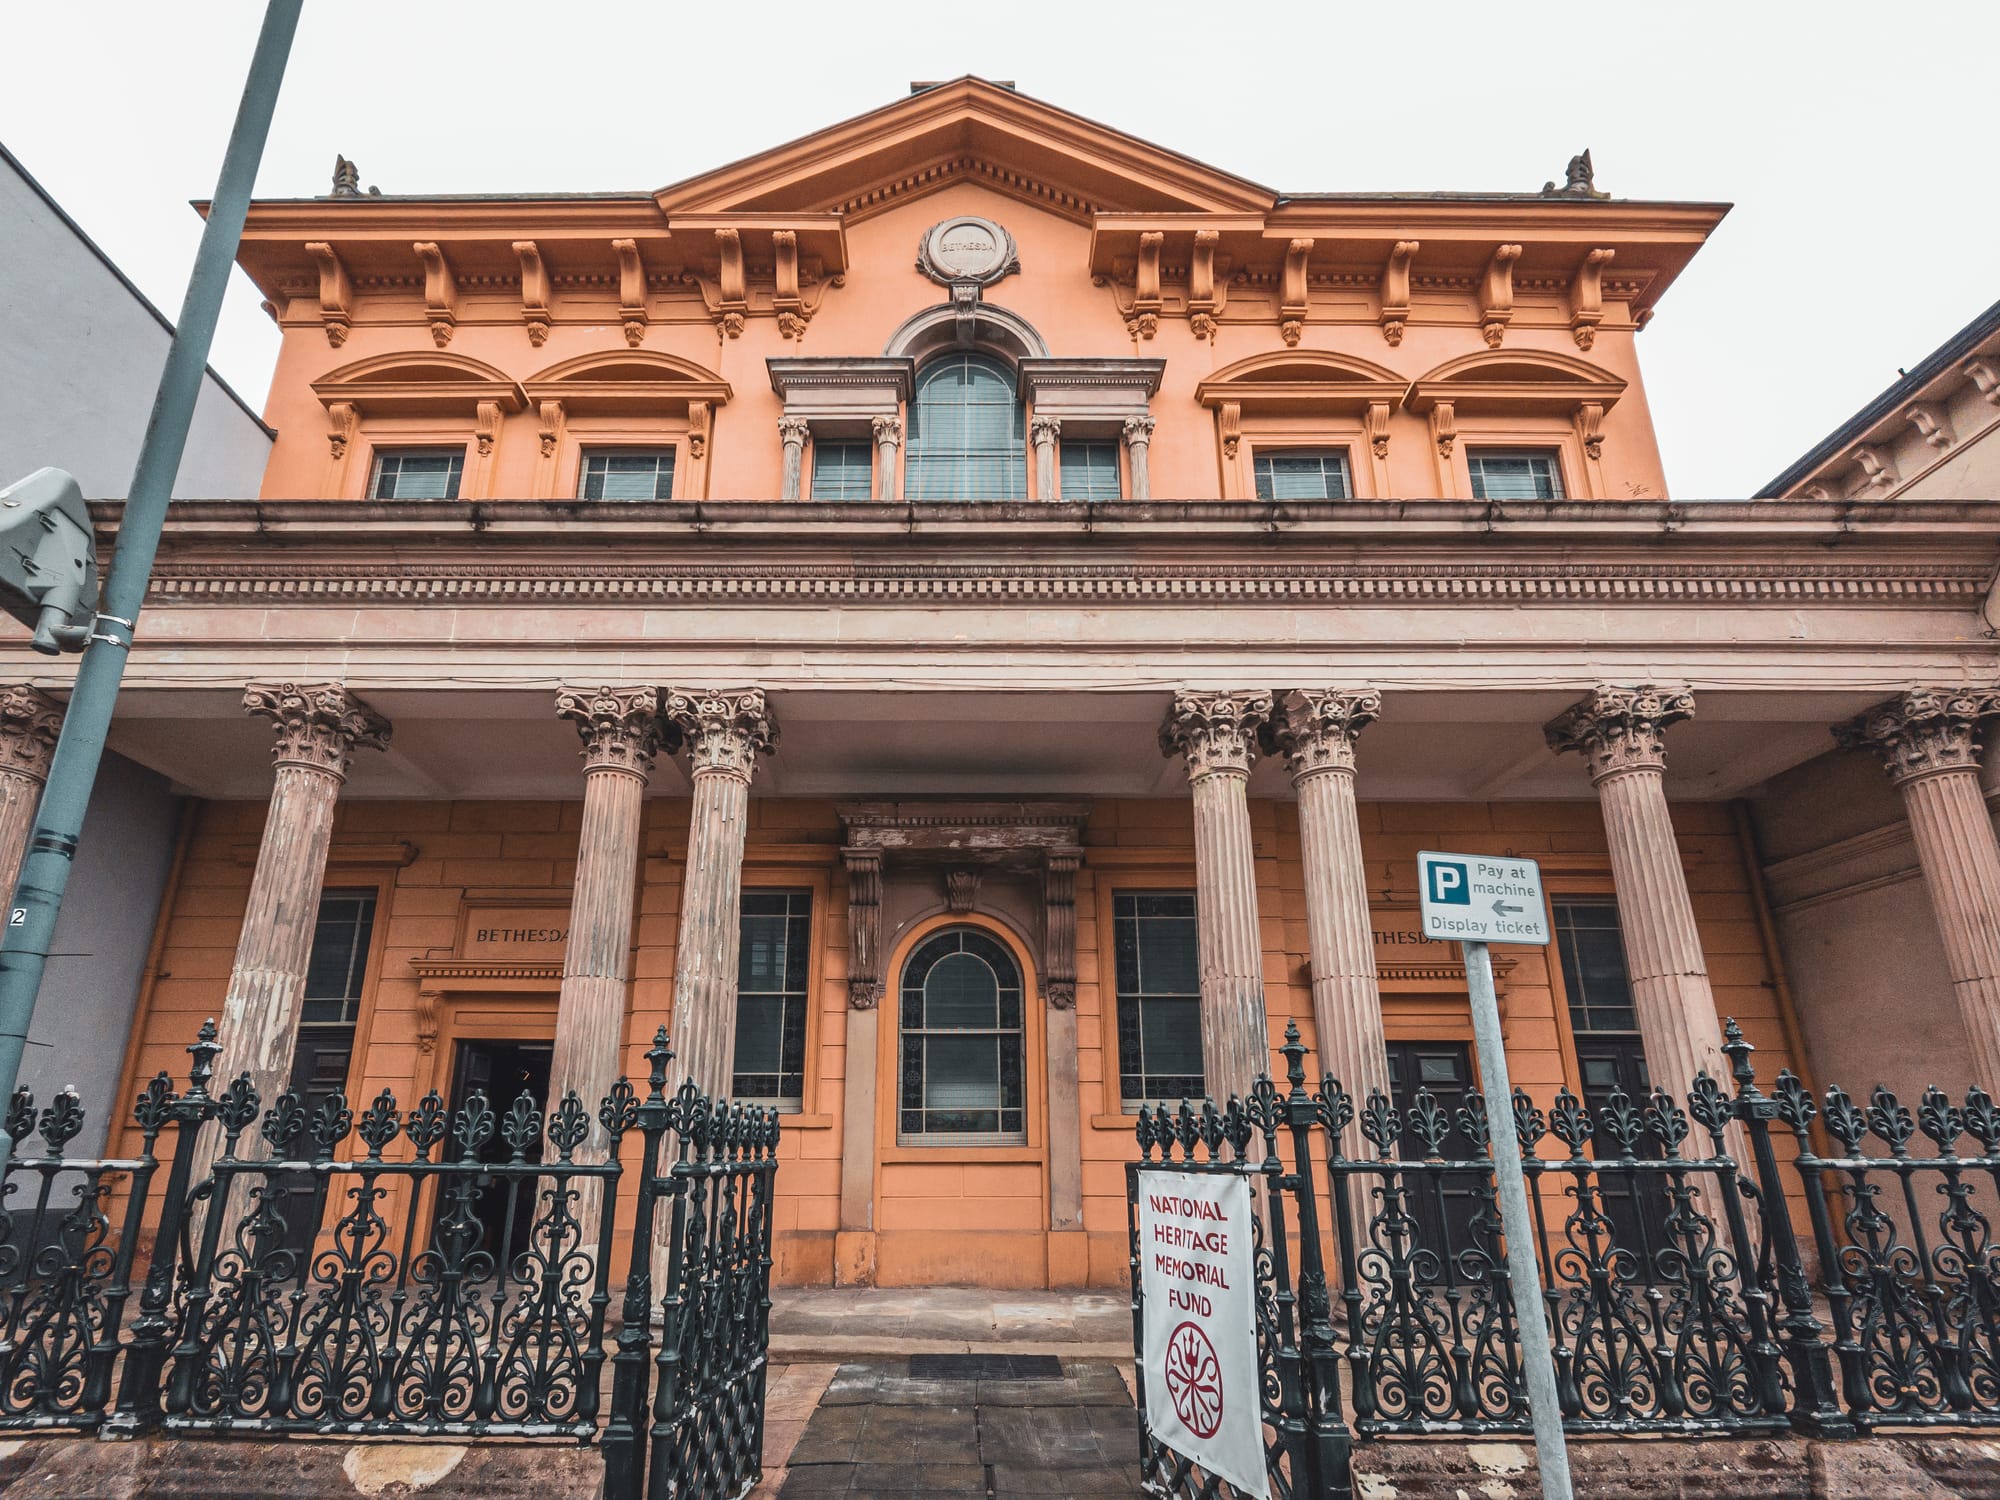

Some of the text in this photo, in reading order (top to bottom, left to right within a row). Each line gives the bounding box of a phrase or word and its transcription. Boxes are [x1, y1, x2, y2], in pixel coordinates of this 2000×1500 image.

[1478, 864, 1526, 879] Pay at
[1435, 866, 1460, 900] P
[1473, 883, 1535, 897] machine
[12, 909, 25, 924] 2
[1431, 916, 1540, 935] Display ticket
[1371, 931, 1442, 944] THESD
[1149, 1195, 1228, 1221] NATIONAL
[1154, 1223, 1228, 1255] HERITAGE
[1155, 1253, 1230, 1290] MEMORIAL
[1169, 1288, 1212, 1318] FUND
